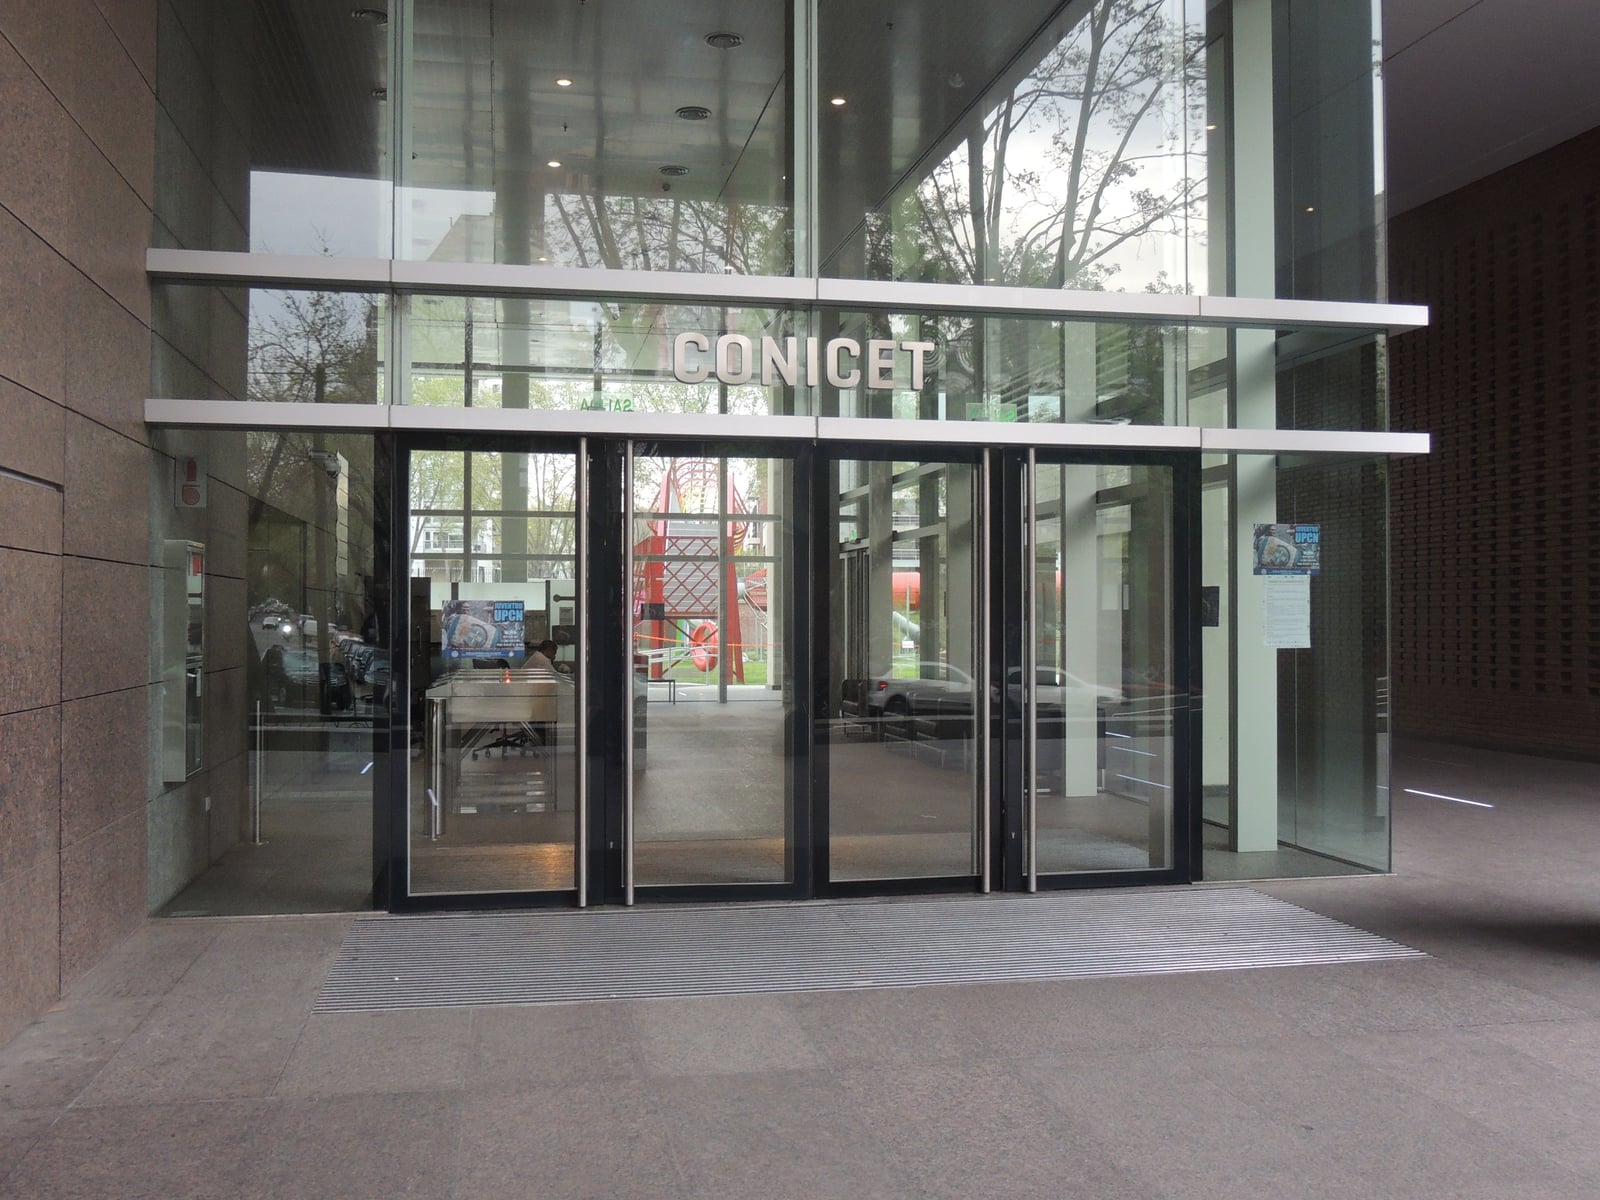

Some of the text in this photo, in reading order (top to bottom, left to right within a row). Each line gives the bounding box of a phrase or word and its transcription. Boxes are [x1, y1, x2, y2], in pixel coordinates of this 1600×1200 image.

[673, 332, 935, 390] CONICET
[1295, 532, 1319, 543] UPCN
[494, 609, 523, 621] UPCN
